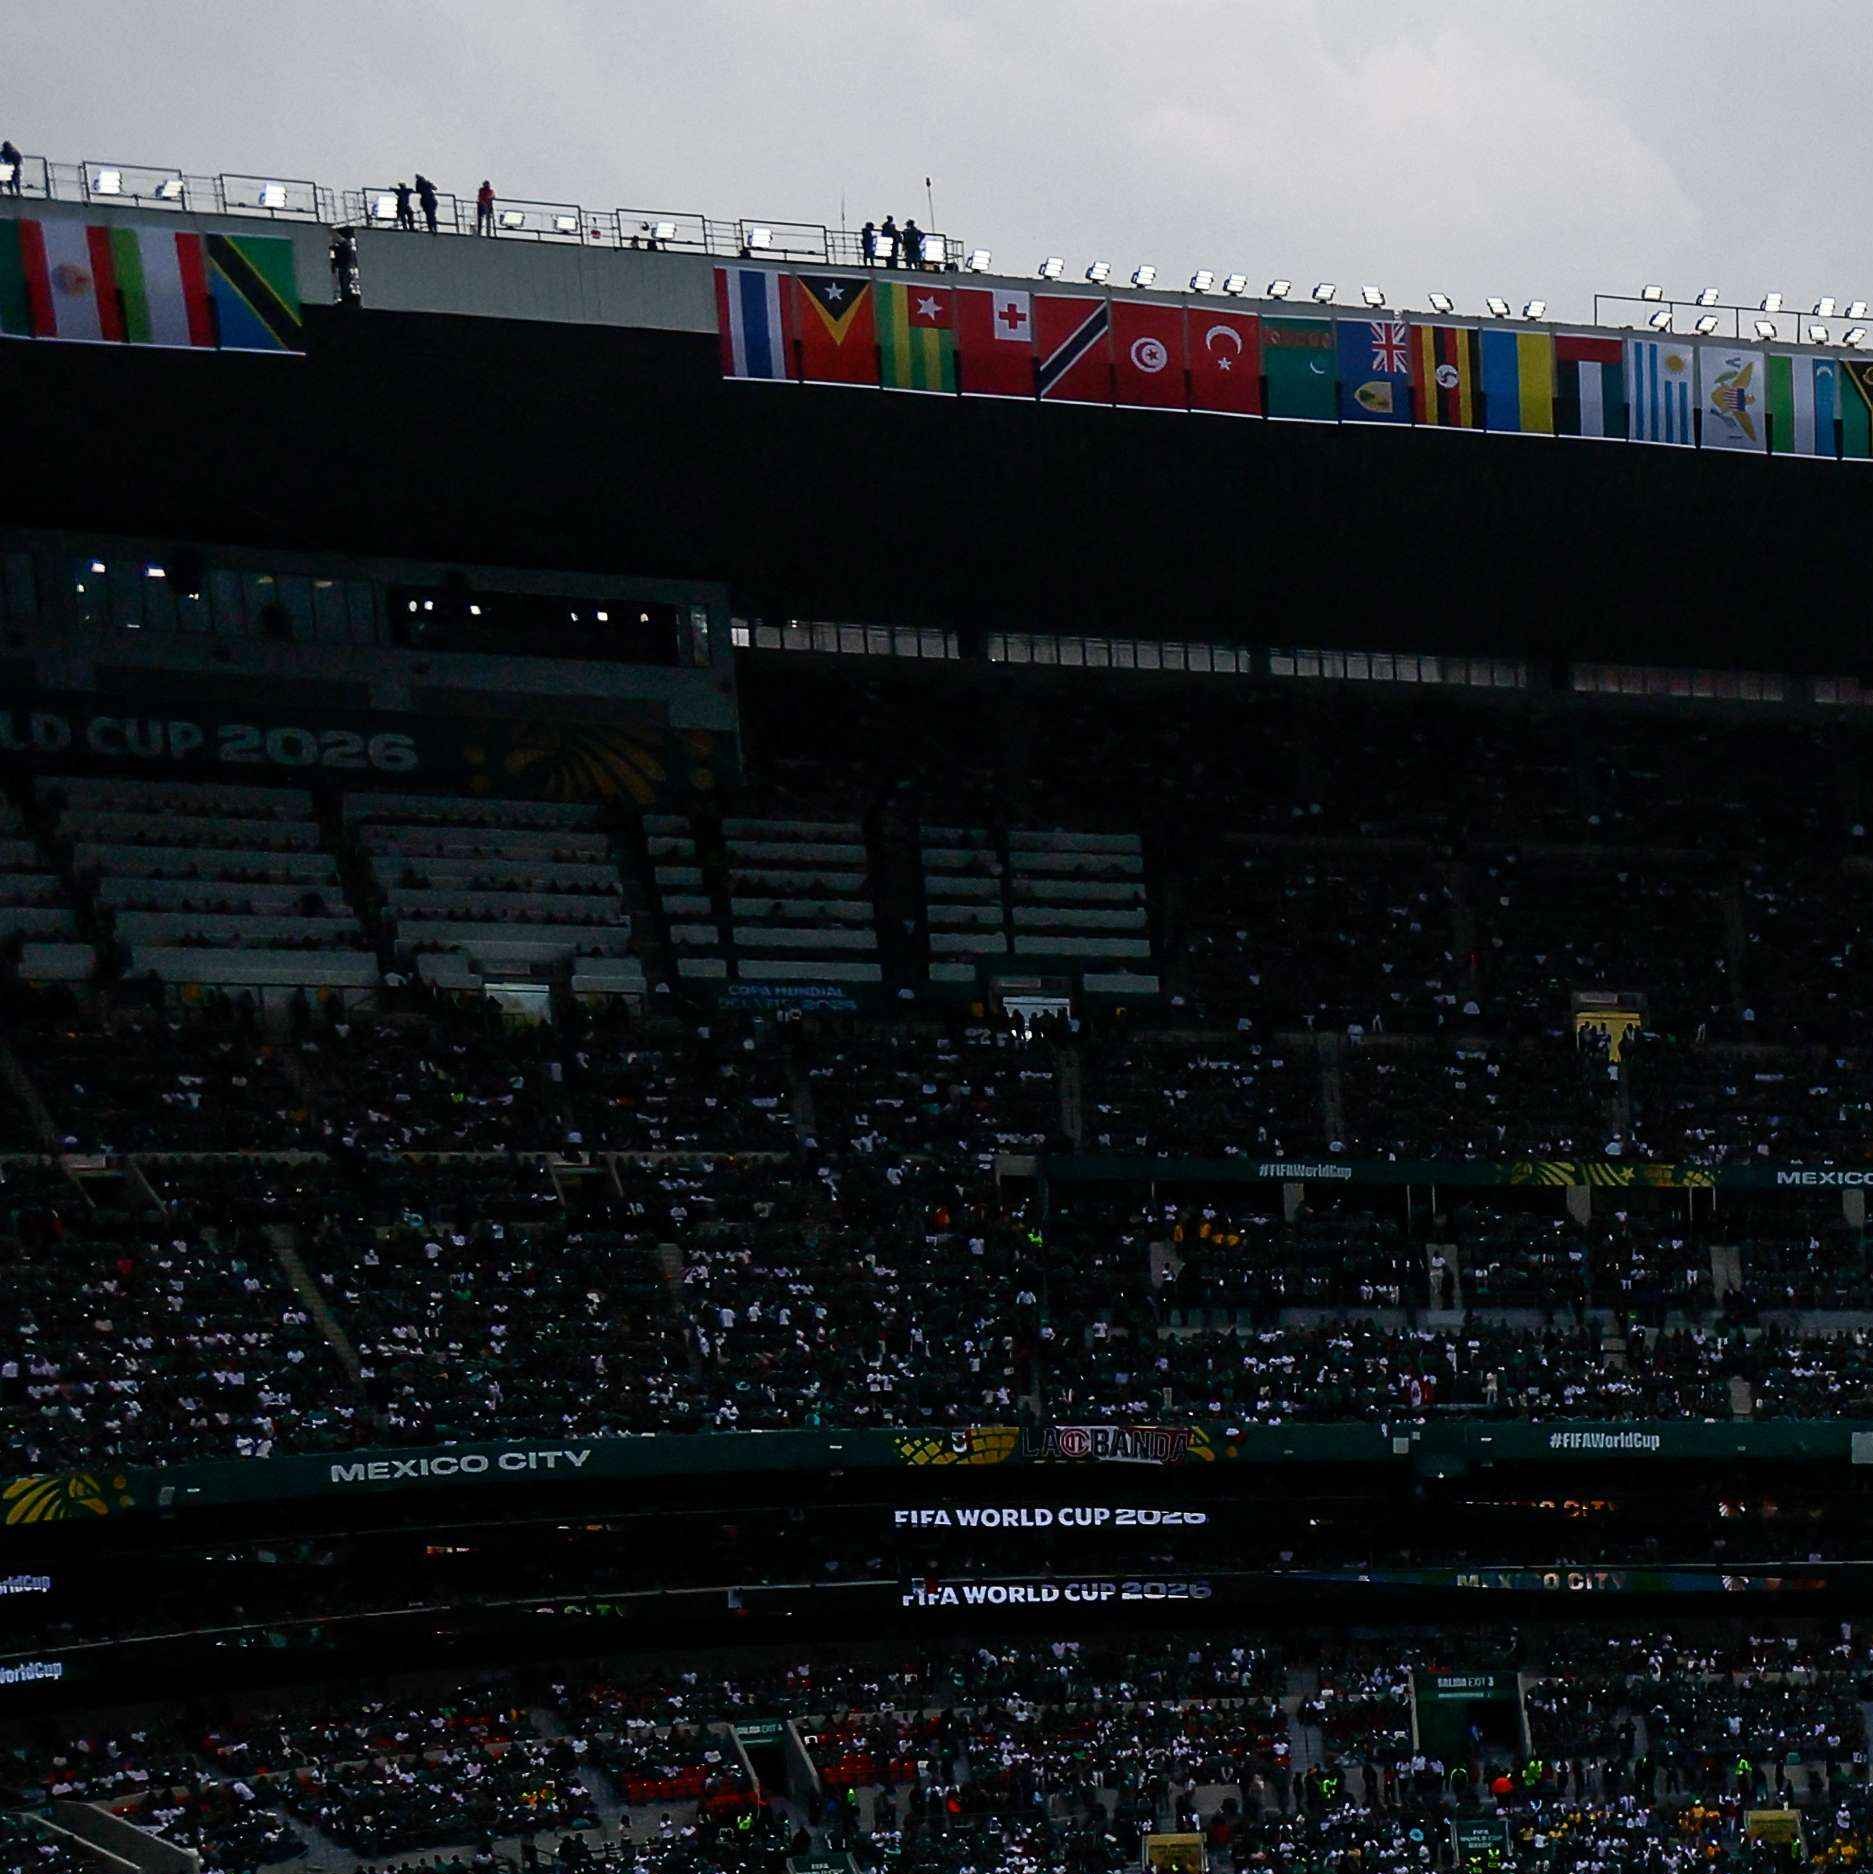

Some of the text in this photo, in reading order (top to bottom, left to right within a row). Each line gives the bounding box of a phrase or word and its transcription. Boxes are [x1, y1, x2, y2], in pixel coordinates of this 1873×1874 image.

[86, 714, 205, 759] CUP
[217, 721, 421, 774] 2026
[1259, 1163, 1353, 1180] #FIFAWorldCup
[1549, 1432, 1662, 1450] #FIFAWorldCup
[330, 1449, 592, 1484] MEXICO CITY
[895, 1508, 1208, 1528] FIFA WORLD CUP 2026
[962, 1584, 1060, 1606] WORLD
[1064, 1582, 1116, 1602] CUP
[1121, 1579, 1215, 1601] 2026
